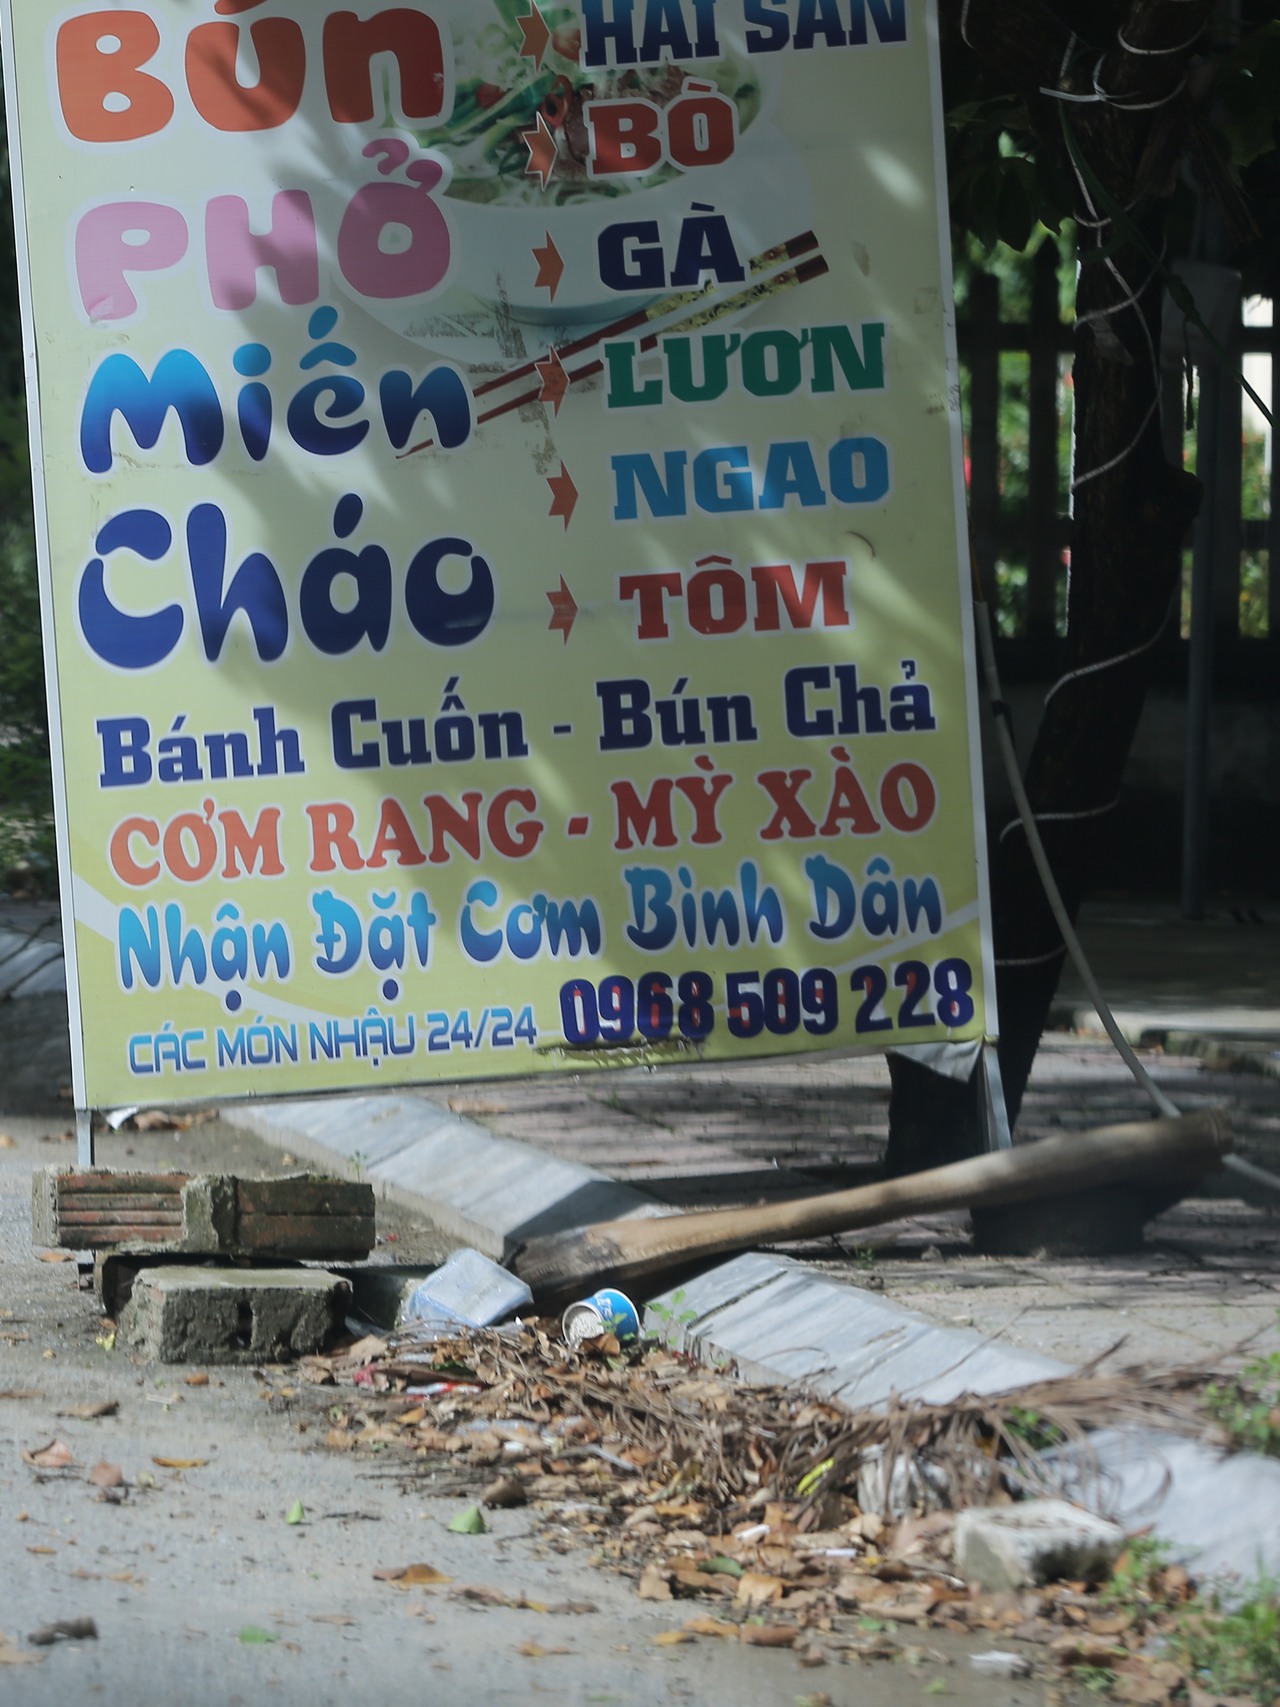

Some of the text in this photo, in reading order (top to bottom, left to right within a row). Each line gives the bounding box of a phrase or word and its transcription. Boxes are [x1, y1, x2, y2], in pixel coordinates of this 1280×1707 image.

[589, 82, 735, 175] BÒ
[75, 138, 450, 320] PHỞ
[598, 202, 746, 291] GÀ
[81, 305, 471, 473] Miến
[604, 322, 885, 409] LƯƠN
[611, 437, 889, 520] NGAO
[79, 493, 495, 669] Cháo
[620, 555, 850, 639] TÔM
[96, 707, 306, 788] Bánh
[331, 676, 528, 769] Cuốn
[596, 677, 758, 751] Bún
[784, 660, 936, 737] Chả
[110, 798, 285, 886] CƠM
[306, 788, 544, 871] RANG
[611, 755, 733, 849] MỲ
[757, 745, 936, 840] XÀO
[119, 854, 942, 1011] Nhận Đặt Cơm Bình Dân
[129, 1006, 537, 1074] CÁC MÓN NHẬU 24/24
[559, 957, 974, 1045] 0968 509 228
